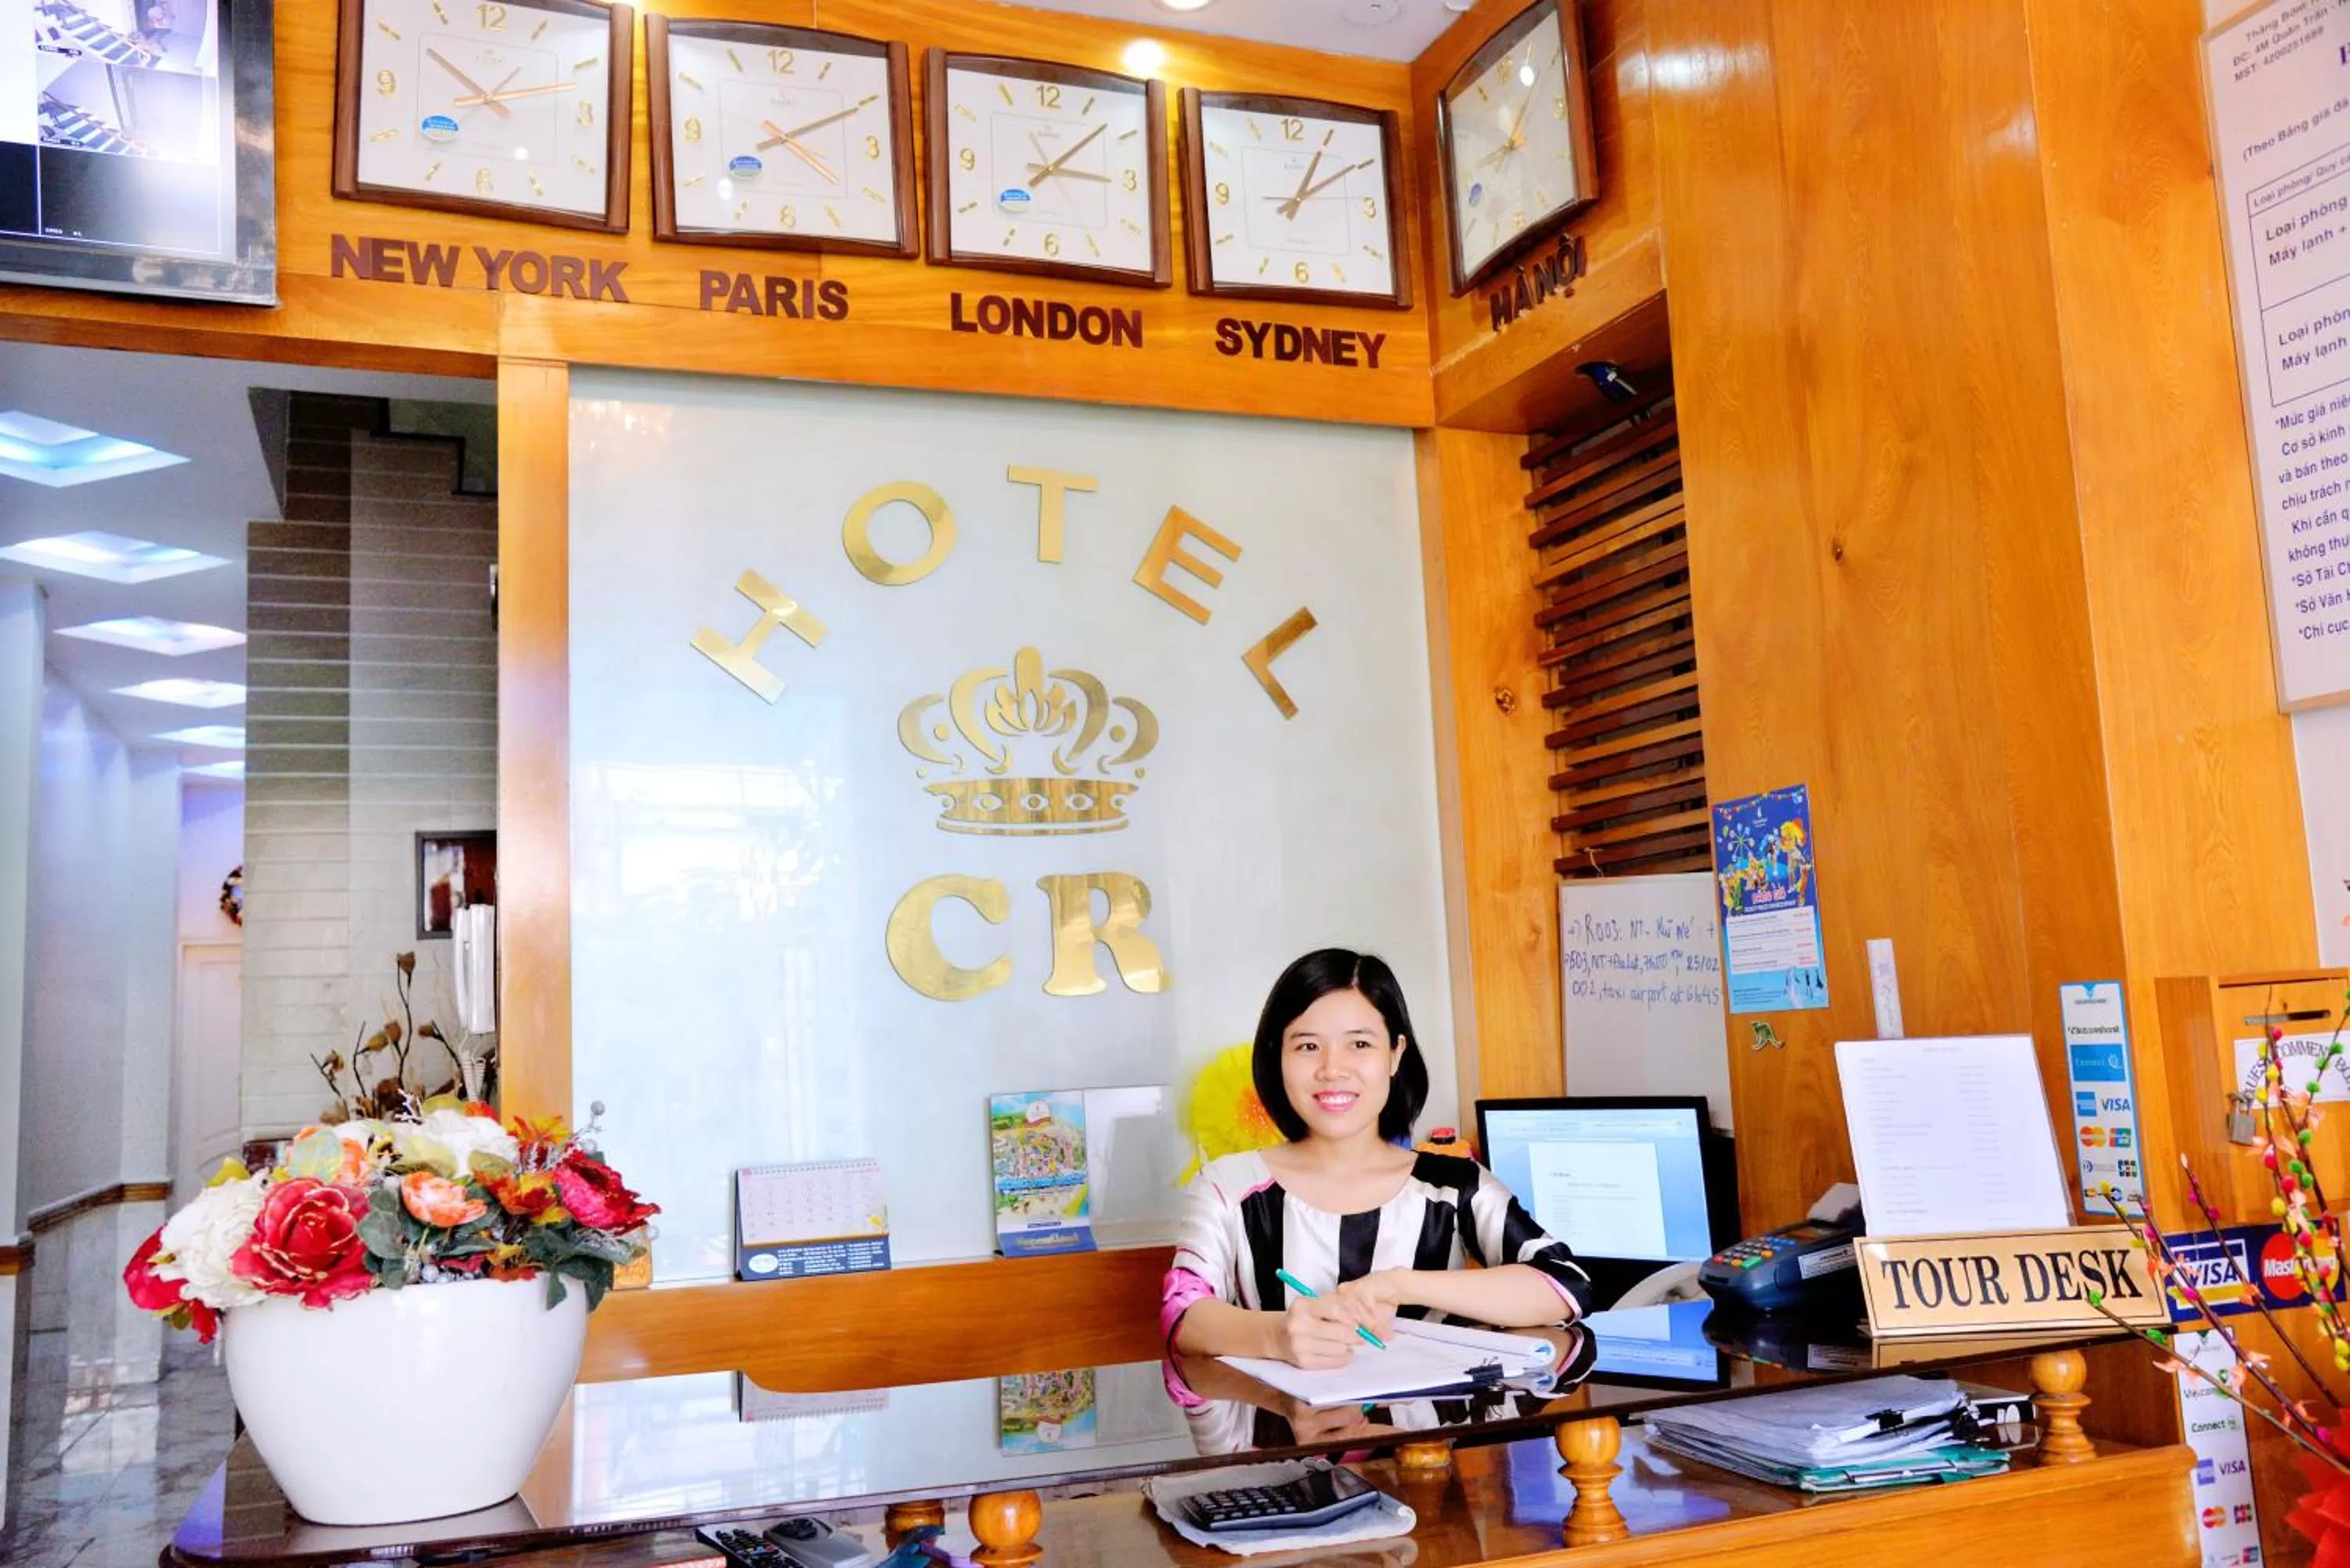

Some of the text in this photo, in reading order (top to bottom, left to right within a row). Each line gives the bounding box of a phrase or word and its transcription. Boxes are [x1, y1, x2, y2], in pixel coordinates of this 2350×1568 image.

[476, 5, 508, 31] 12
[768, 49, 796, 75] 12
[377, 70, 396, 96] 9
[1036, 85, 1062, 110] 12
[577, 100, 595, 125] 3
[684, 119, 703, 145] 9
[1280, 117, 1305, 143] 12
[864, 136, 880, 161] 3
[960, 148, 977, 172] 9
[2243, 137, 2276, 162] (Theo
[476, 168, 495, 195] 6
[1123, 168, 1138, 193] 3
[1215, 181, 1231, 205] 9
[779, 204, 797, 228] 6
[1362, 197, 1377, 220] 3
[2266, 196, 2348, 241] Loại phòng
[1043, 233, 1059, 257] 6
[2269, 245, 2297, 266] Máy
[331, 234, 629, 302] NEW YORK
[1294, 262, 1310, 285] 6
[700, 269, 848, 320] PARIS
[1491, 233, 1586, 331] HÀ NỘI
[951, 292, 1142, 349] LONDON
[1216, 317, 1386, 369] SYDNEY
[2279, 323, 2308, 345] Loại
[2282, 337, 2348, 370] Máy lạnh
[2307, 403, 2326, 424] giá
[2301, 432, 2316, 450] sở
[2319, 425, 2346, 443] kinh
[2279, 453, 2348, 483] và bán theo
[2282, 493, 2307, 511] chịu
[2310, 482, 2341, 500] trách
[2292, 520, 2312, 535] Khi
[2316, 510, 2337, 527] cần
[2288, 543, 2326, 562] không
[2316, 565, 2334, 582] Tài
[689, 464, 1319, 721] HOTEL
[2319, 591, 2343, 609] Văn
[2328, 619, 2349, 636] cục
[886, 871, 1173, 1002] CR
[2102, 1098, 2131, 1111] VISA
[1882, 1249, 2142, 1310] TOUR DESK
[2189, 1262, 2239, 1286] VISA
[2192, 1418, 2226, 1433] Connect
[2219, 1460, 2247, 1476] VISA
